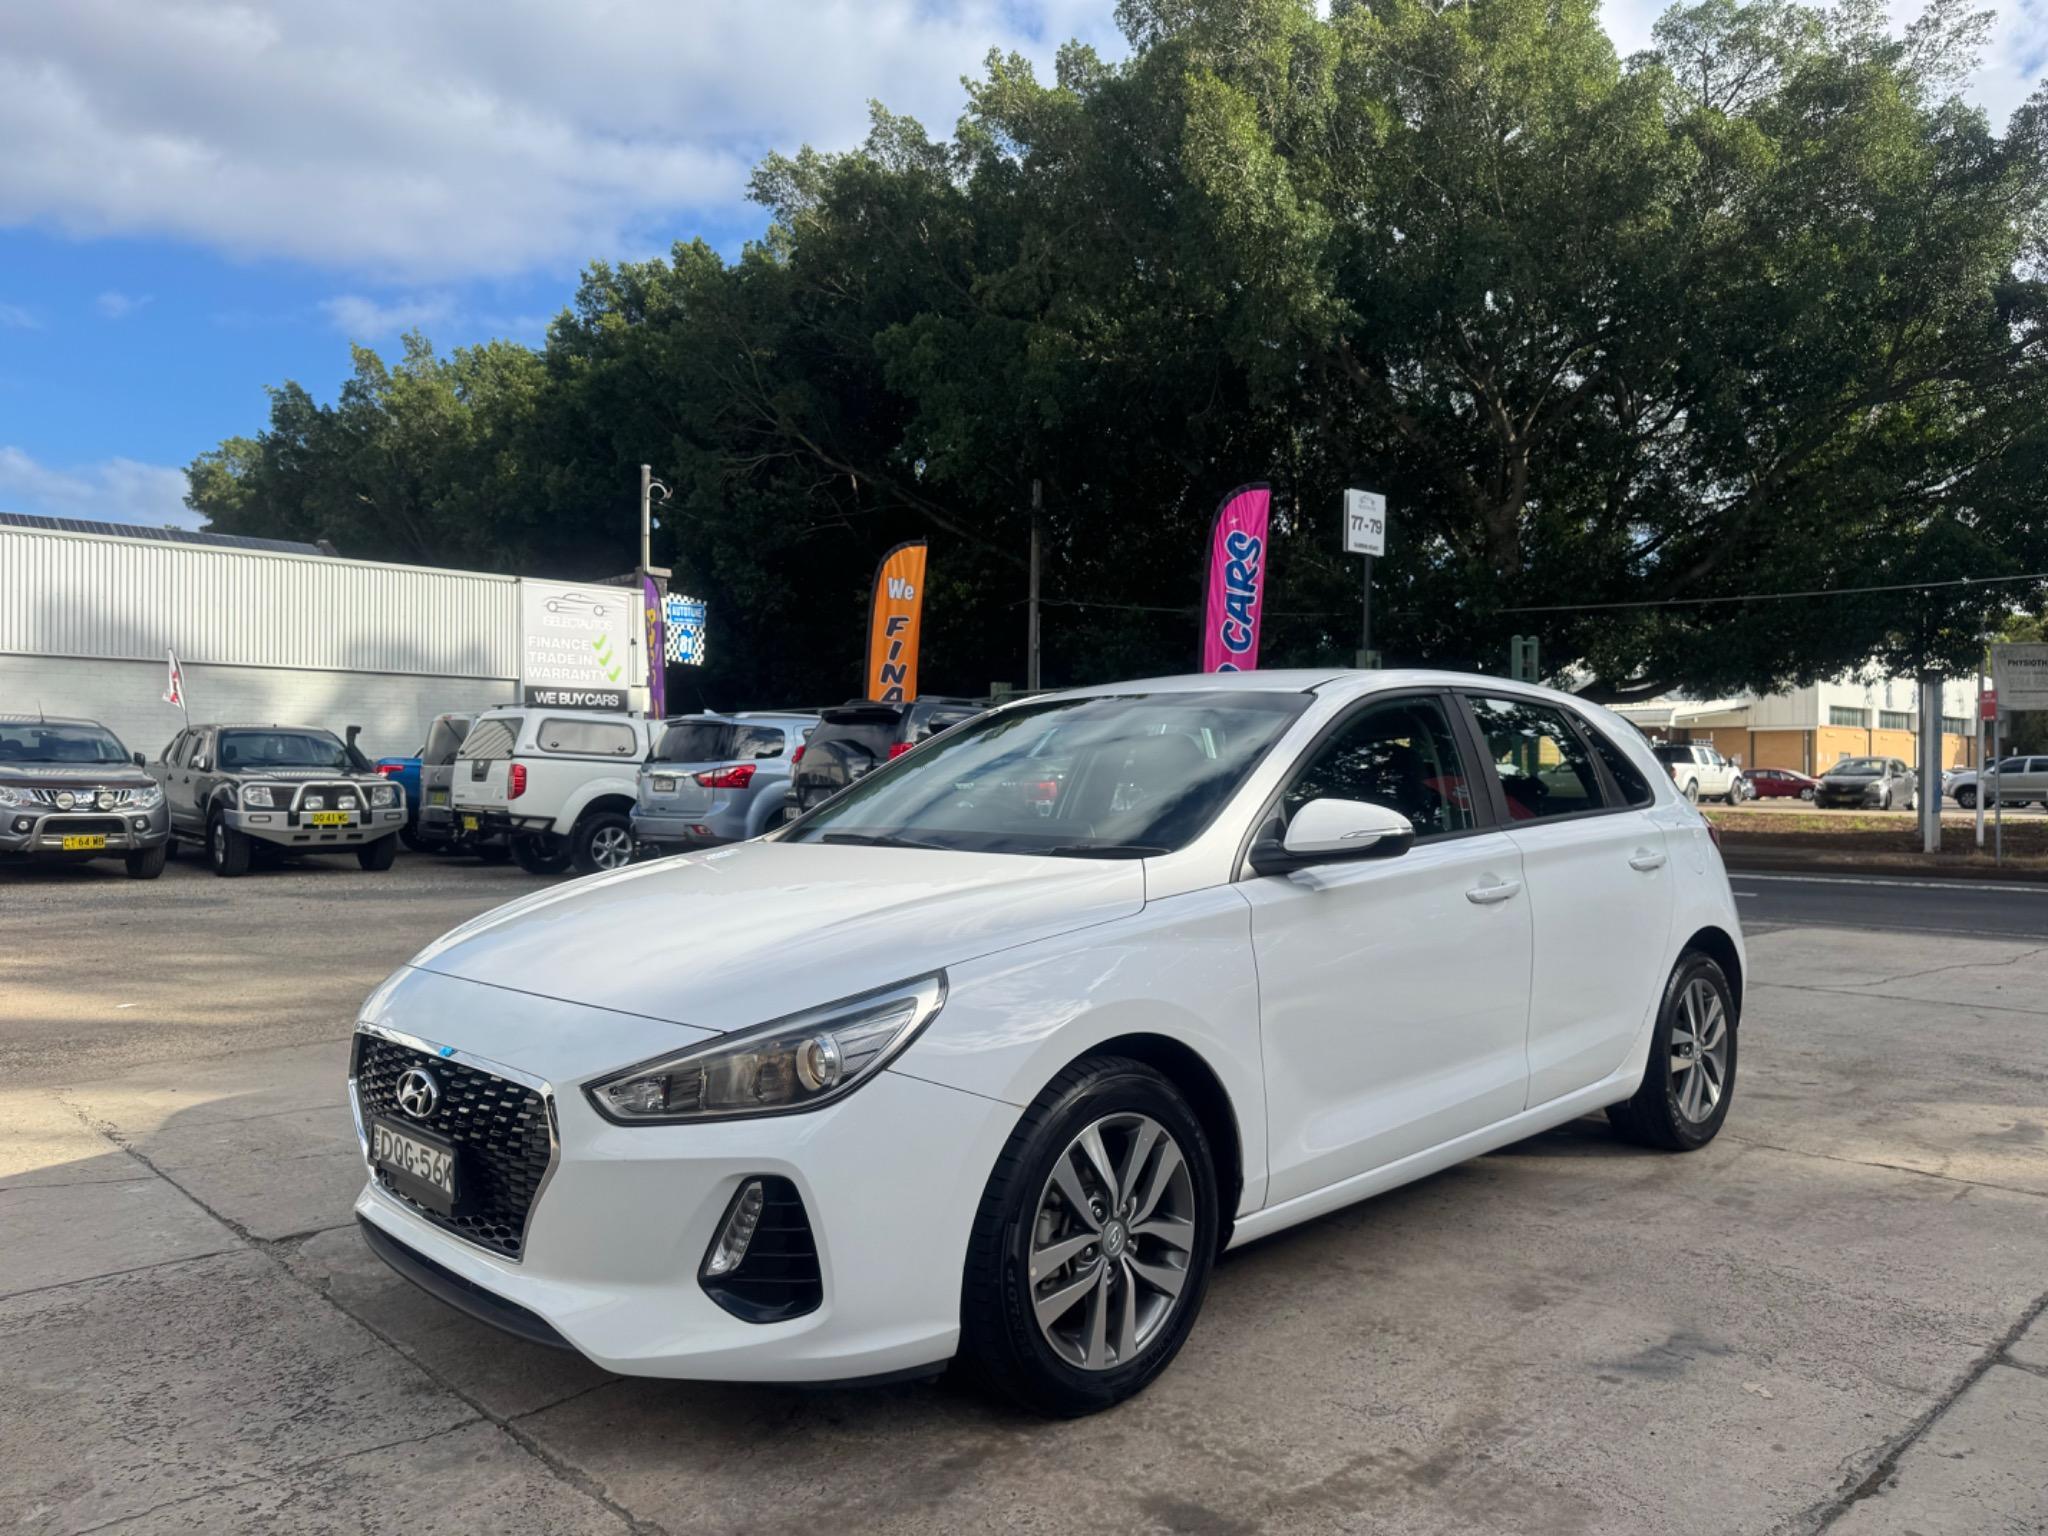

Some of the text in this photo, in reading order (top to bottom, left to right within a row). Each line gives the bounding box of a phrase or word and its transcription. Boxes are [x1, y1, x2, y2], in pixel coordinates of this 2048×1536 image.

[888, 577, 914, 600] We
[1220, 530, 1263, 654] CARS
[528, 635, 591, 650] FINANCE
[528, 651, 576, 665] TRADE
[528, 666, 609, 681] WARRANTY
[534, 691, 619, 707] WE BUY CARS
